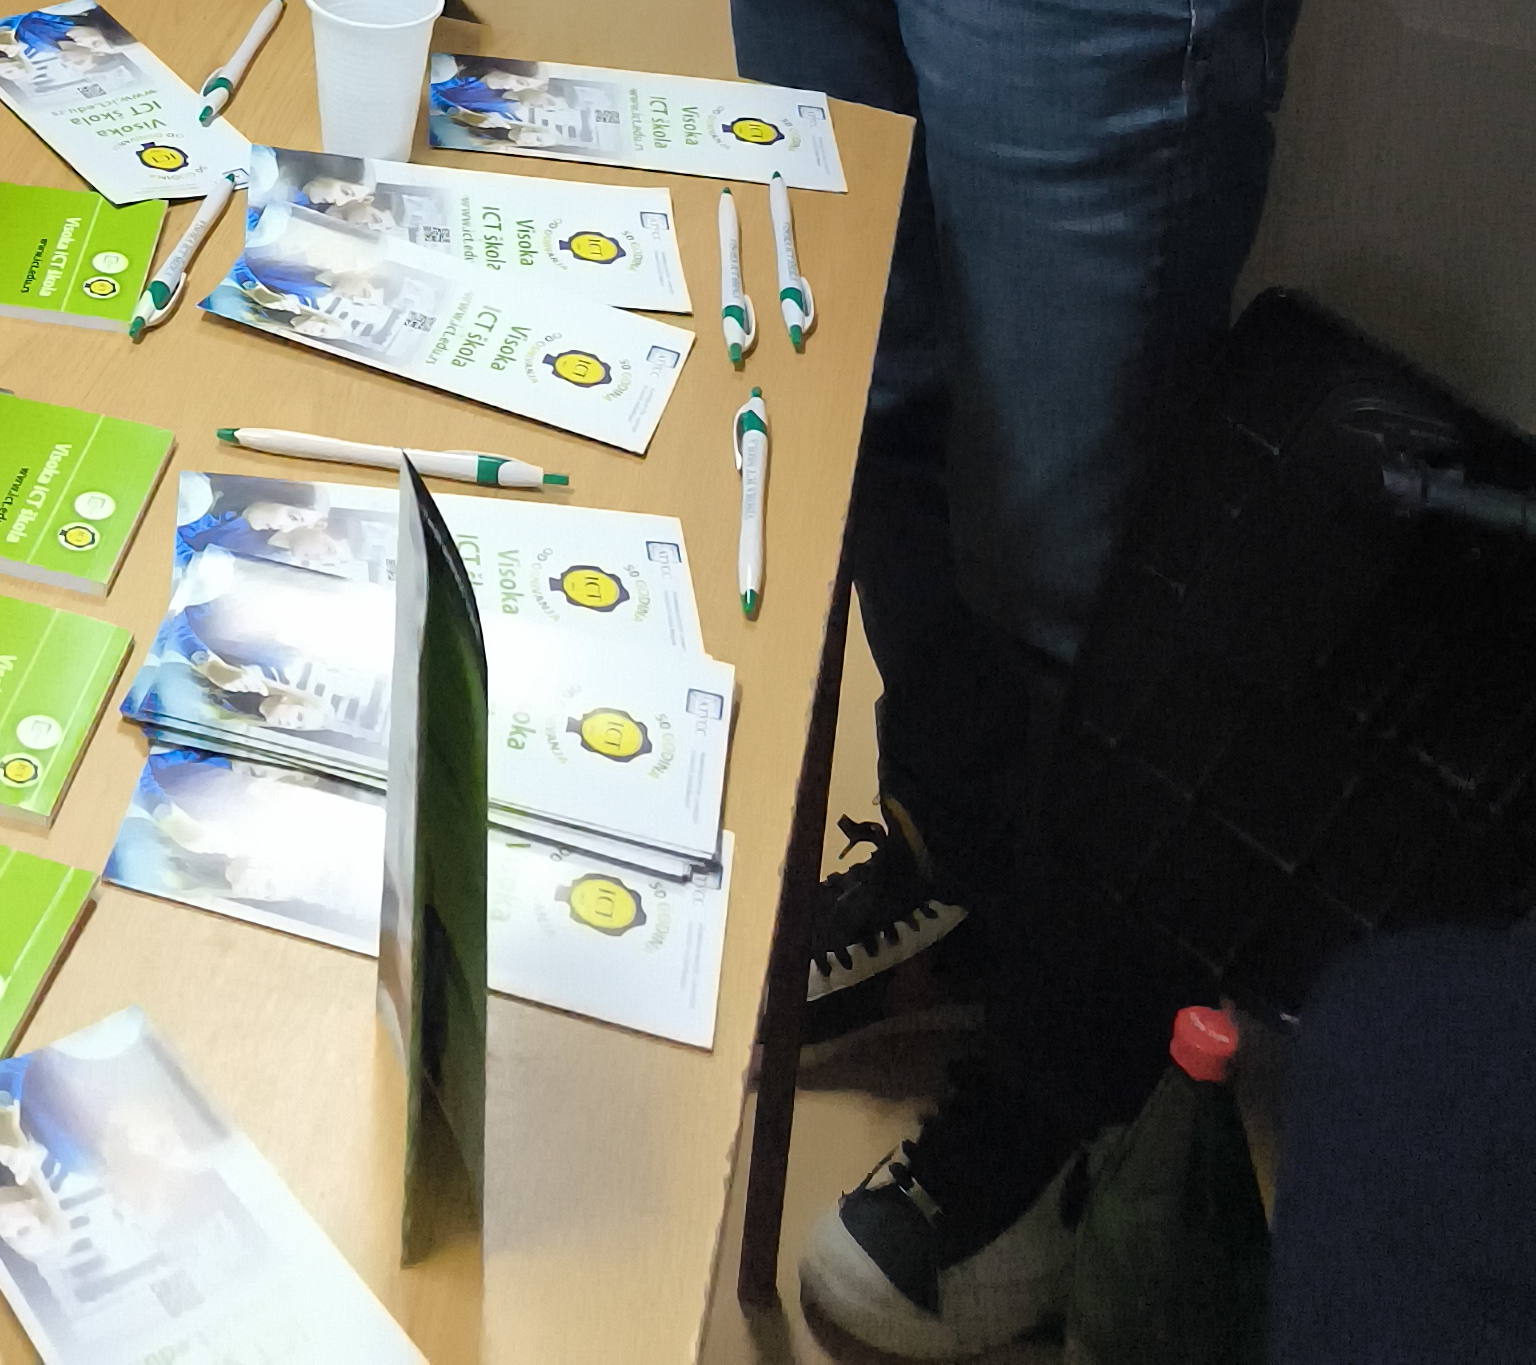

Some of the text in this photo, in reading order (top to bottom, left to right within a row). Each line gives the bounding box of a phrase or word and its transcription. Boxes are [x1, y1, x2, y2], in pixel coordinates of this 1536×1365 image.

[69, 100, 162, 126] ICT škola
[96, 119, 167, 137] Visoka
[650, 96, 672, 149] ICT škola
[682, 106, 702, 146] Visoka
[749, 123, 763, 138] ICT
[482, 206, 503, 231] ICT
[56, 217, 82, 252] Visoka
[516, 219, 539, 266] Visoka
[588, 238, 603, 257] ICT
[50, 247, 69, 271] ICT
[451, 305, 502, 368] ICT škola
[491, 326, 532, 371] Visoka
[572, 359, 592, 378] ICT
[6, 443, 72, 543] Visoka ICT škola
[456, 534, 481, 566] ICT
[497, 549, 525, 615] Visoka
[585, 577, 602, 601] ICT
[604, 722, 625, 750] ICT
[594, 887, 616, 919] ICT
[648, 881, 667, 899] 50
